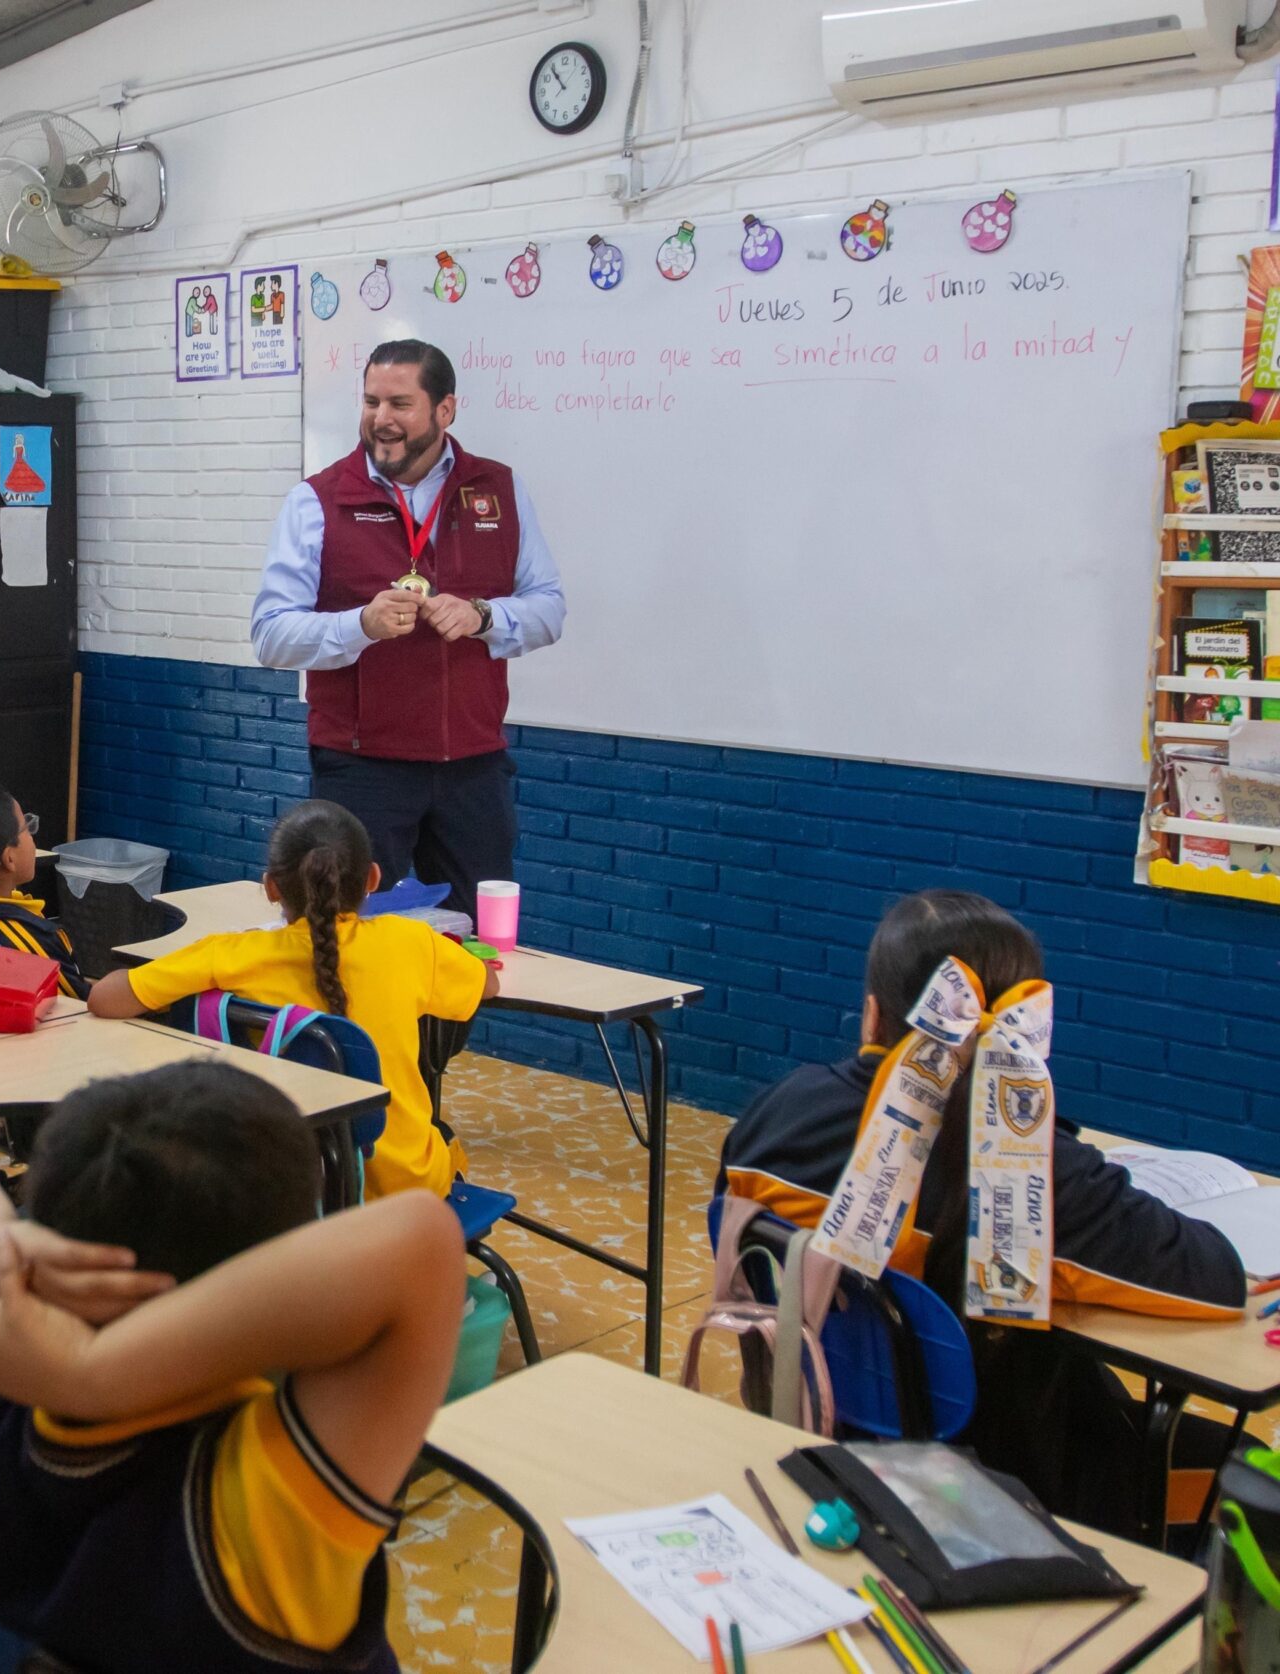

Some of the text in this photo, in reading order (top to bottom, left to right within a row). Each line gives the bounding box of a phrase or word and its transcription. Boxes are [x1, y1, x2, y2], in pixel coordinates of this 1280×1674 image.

[561, 56, 569, 66] 12
[573, 58, 577, 67] 1
[581, 66, 587, 75] 2
[543, 74, 551, 83] 10
[584, 79, 590, 88] 3
[540, 87, 546, 97] 9
[581, 93, 587, 102] 4
[544, 101, 550, 110] 8
[573, 105, 580, 114] 5
[552, 109, 558, 119] 7
[562, 110, 568, 120] 6
[714, 283, 805, 323] Jueves
[832, 287, 854, 323] 5
[877, 276, 909, 307] de
[923, 270, 986, 303] Junio
[259, 328, 282, 340] hope
[192, 341, 212, 351] How
[252, 339, 285, 352] you are
[185, 350, 219, 364] are you?
[461, 337, 513, 385] dibuja
[535, 349, 565, 367] una
[581, 338, 636, 381] figura
[659, 348, 691, 376] que
[711, 347, 742, 368] sea
[774, 333, 897, 367] simétrica
[923, 344, 938, 364] a
[964, 322, 987, 360] la
[1014, 320, 1095, 357] mitad
[1114, 326, 1133, 377] y
[186, 364, 220, 375] (Greeting)
[251, 359, 287, 371] (Greeting)
[495, 382, 541, 411] debe
[1195, 636, 1202, 644] El
[1228, 637, 1241, 645] del
[1197, 645, 1239, 653] embustero
[985, 1078, 997, 1127] Elena
[877, 1127, 901, 1164] Elena
[855, 1166, 901, 1243] ELENA
[1026, 1174, 1046, 1226] Elena
[823, 1191, 856, 1238] Elena
